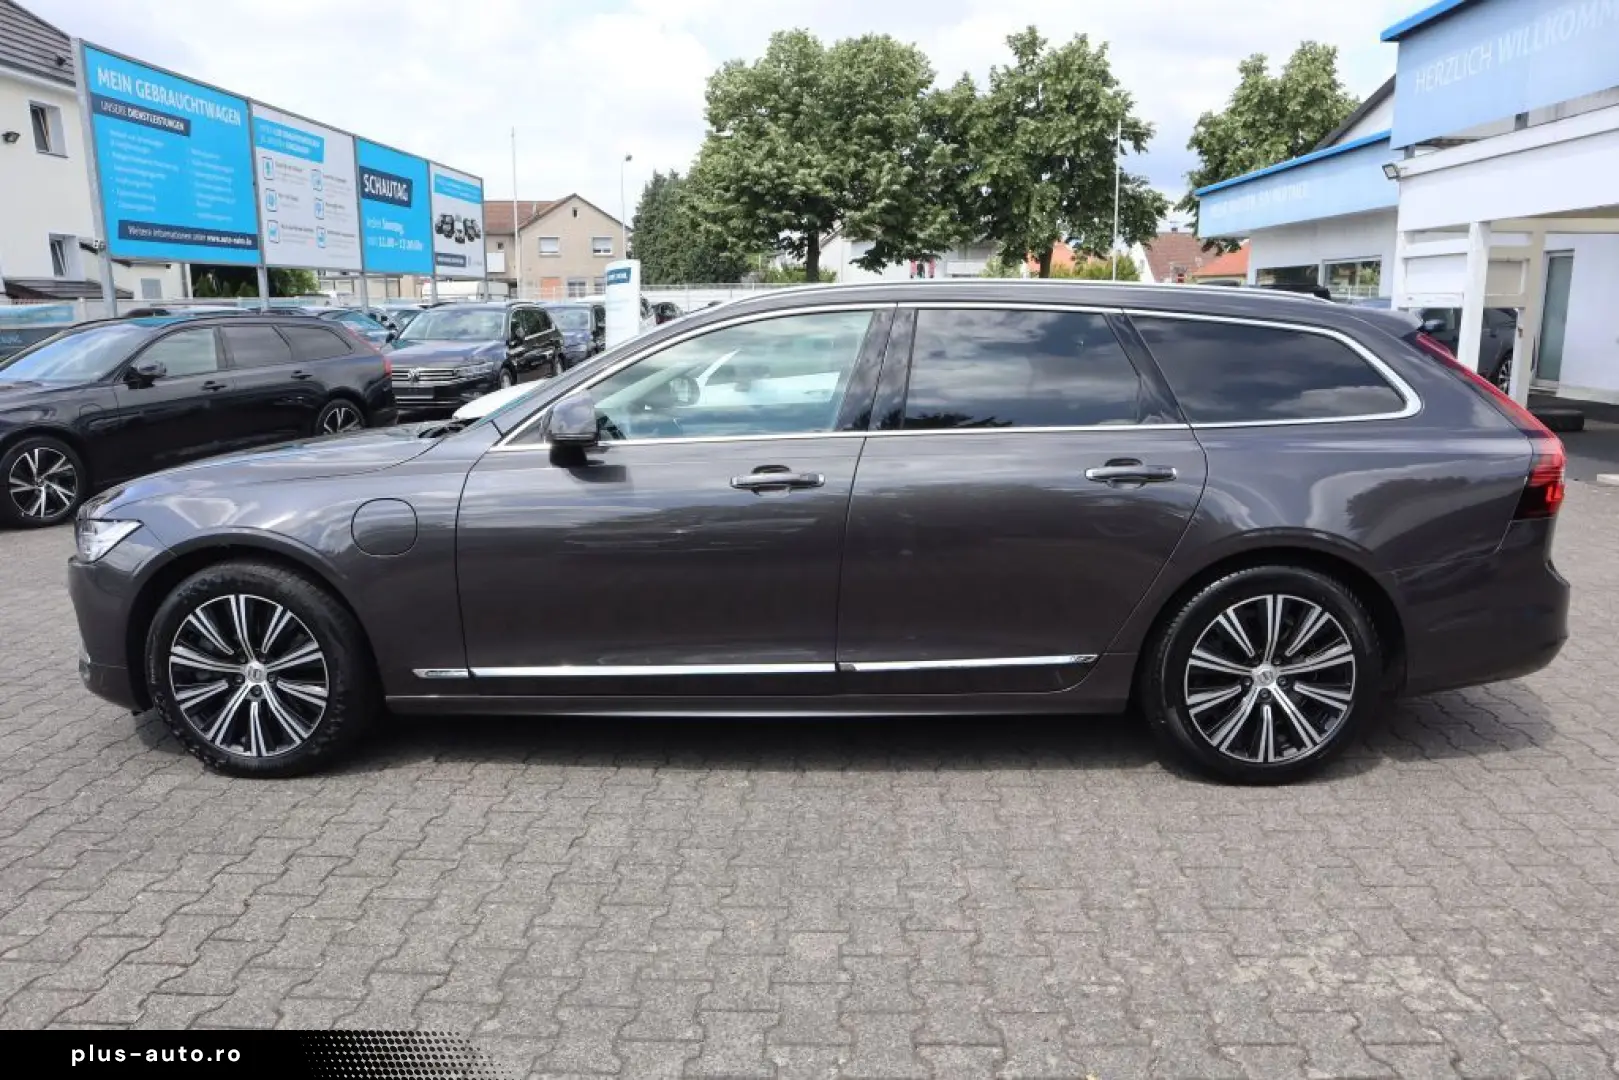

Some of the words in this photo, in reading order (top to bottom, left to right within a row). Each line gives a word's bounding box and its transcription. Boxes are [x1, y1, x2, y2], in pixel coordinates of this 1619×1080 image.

[1414, 41, 1493, 95] HERZLICH
[97, 66, 132, 94] MEIN
[136, 79, 241, 126] GEBRAUCHTWAGEN
[127, 107, 185, 131] DIENSTLEISTUNGEN
[363, 173, 409, 202] SCHAUTAG
